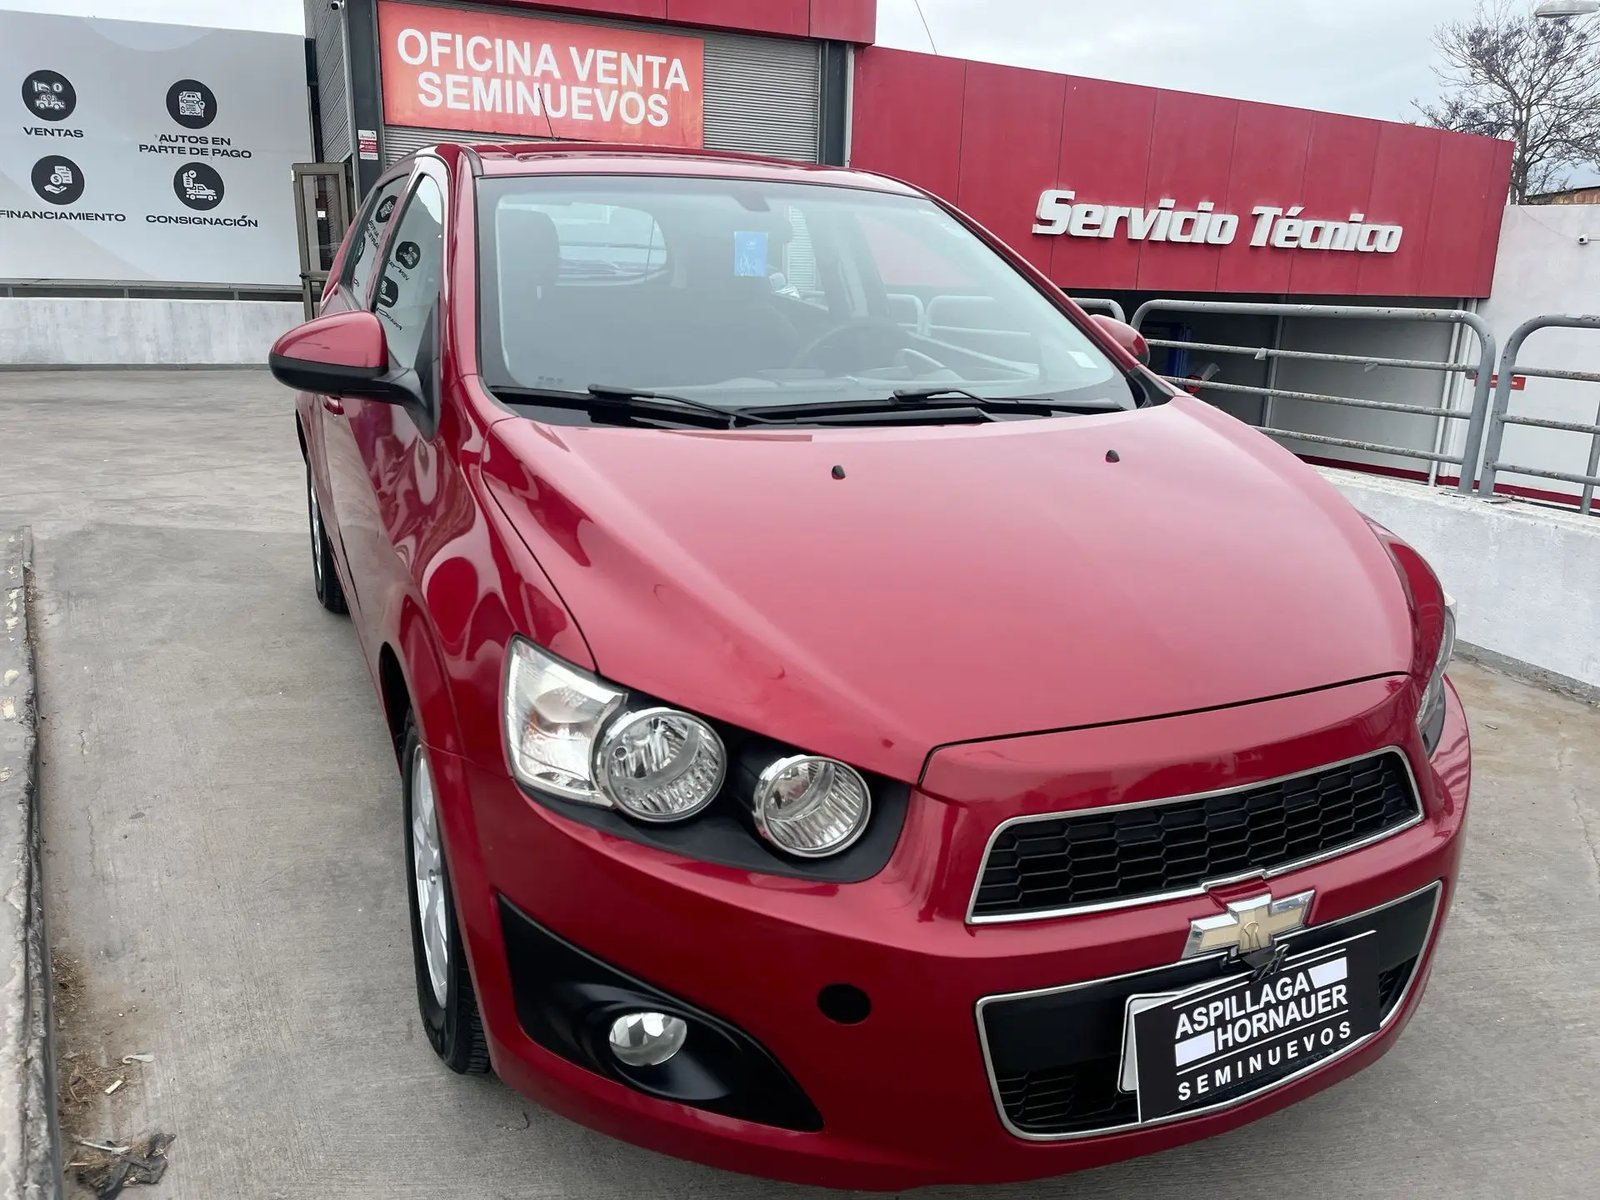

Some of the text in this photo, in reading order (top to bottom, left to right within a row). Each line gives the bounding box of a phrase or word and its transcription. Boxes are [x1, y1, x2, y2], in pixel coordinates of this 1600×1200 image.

[397, 28, 689, 92] OFICINA VENTA
[417, 71, 669, 128] SEMINUEVOS
[23, 126, 84, 138] VENTAS
[138, 143, 252, 159] PARTE DE PAGO
[158, 134, 231, 146] AUTOS EN
[0, 210, 126, 222] FINANCIAMIENTO
[145, 214, 258, 228] CONSIGNACIÓN
[1032, 188, 1403, 254] Servicio Técnico
[1175, 972, 1310, 1039] ASPILLAGA
[1217, 984, 1349, 1051] HORNAUER
[1178, 1021, 1351, 1101] SEMINUEVOS
